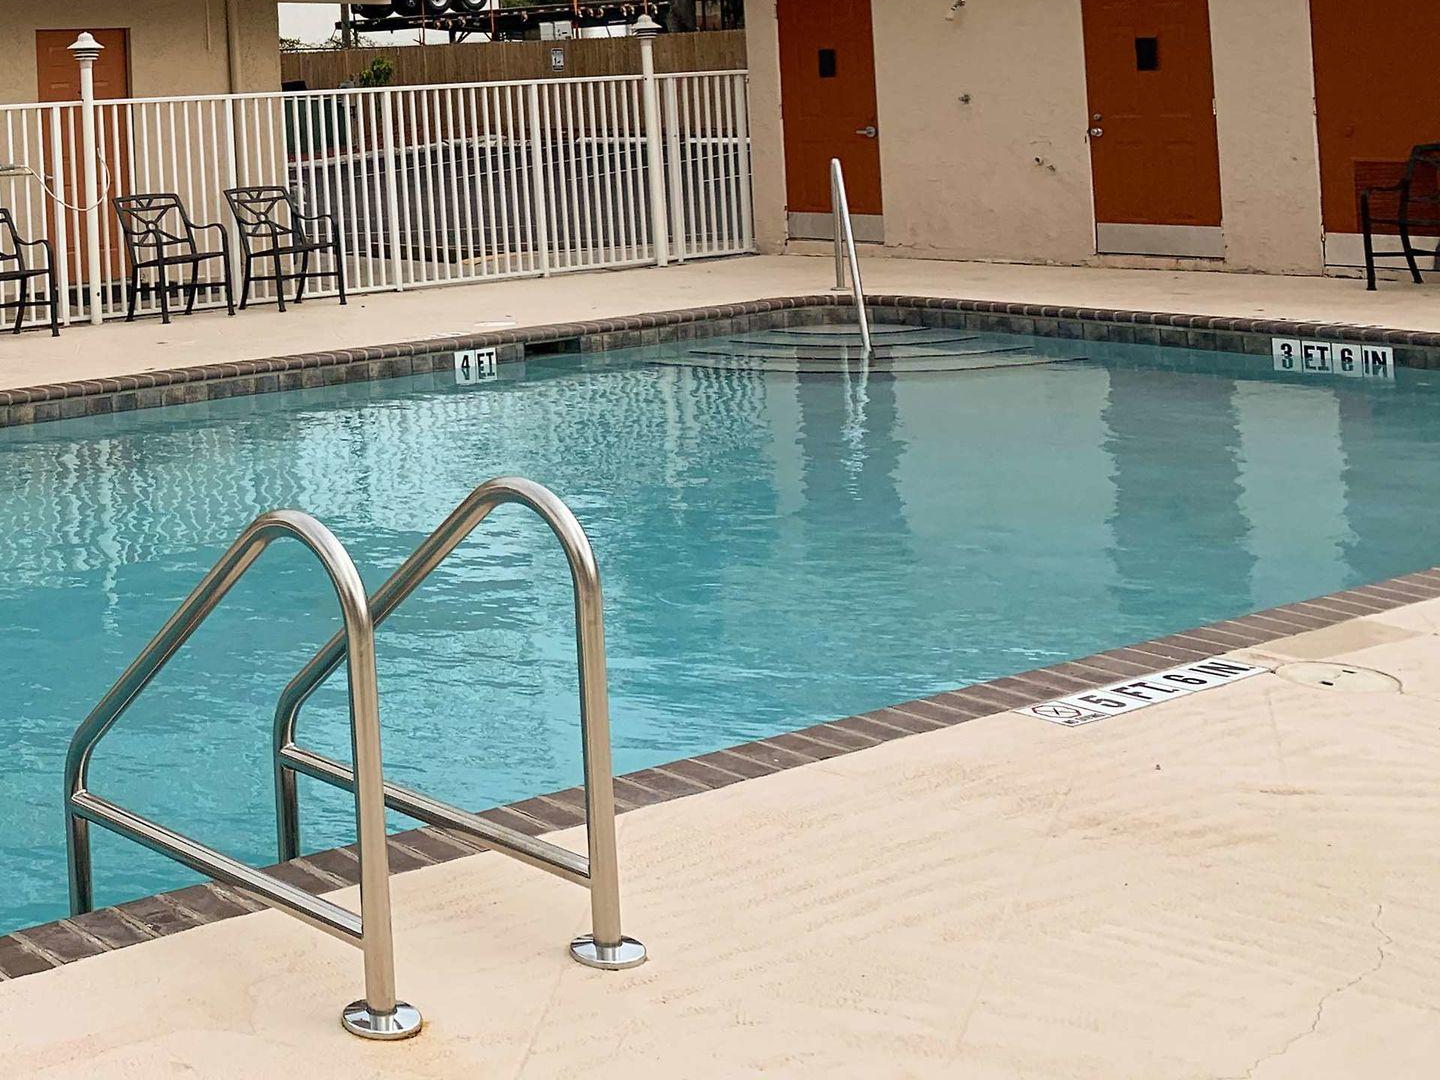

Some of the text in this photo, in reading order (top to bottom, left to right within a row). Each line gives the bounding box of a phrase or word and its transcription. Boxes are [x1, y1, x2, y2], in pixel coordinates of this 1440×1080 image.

[1303, 345, 1329, 364] FT
[1363, 349, 1387, 369] IN
[1078, 694, 1127, 708] 5
[1162, 674, 1208, 685] 6
